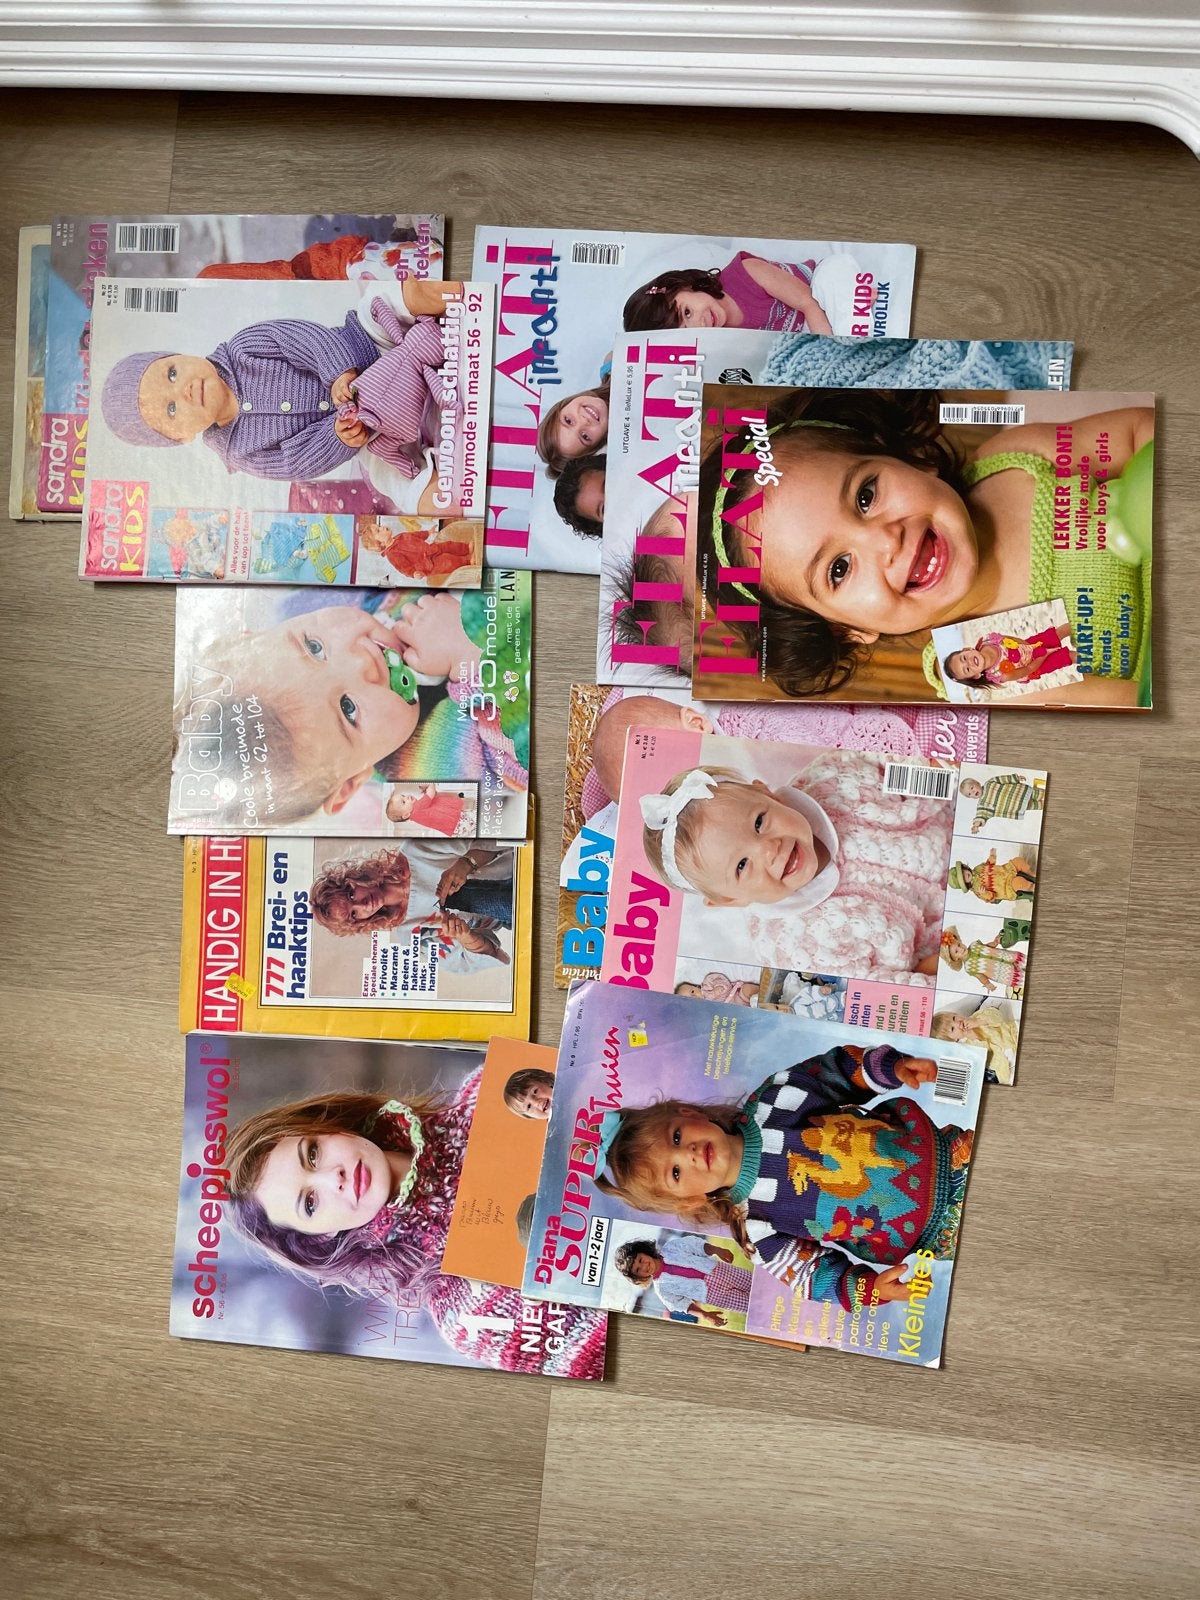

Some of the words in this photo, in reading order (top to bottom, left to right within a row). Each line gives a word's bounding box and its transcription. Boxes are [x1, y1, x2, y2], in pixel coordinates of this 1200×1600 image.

[468, 293, 483, 312] 92
[852, 272, 874, 317] KIDS
[874, 282, 890, 338] VROLIJK
[467, 328, 481, 348] 56
[528, 254, 562, 386] infanti
[438, 292, 466, 402] schattig!
[466, 352, 480, 395] maat
[464, 400, 478, 416] in
[669, 354, 706, 492] infanti
[622, 422, 630, 454] UITGAVE
[740, 416, 783, 486] Special
[1055, 425, 1073, 478] BONT!
[1096, 432, 1112, 463] girls
[41, 418, 68, 504] sandra
[432, 408, 457, 509] Gewoon
[460, 421, 478, 508] Babymode
[1077, 456, 1090, 492] mode
[1096, 468, 1108, 478] &
[1054, 486, 1071, 550] LEKKER
[1094, 484, 1110, 516] boys
[94, 484, 124, 570] sandra
[119, 486, 145, 572] KIDS
[1075, 498, 1092, 550] Vrolijke
[1096, 520, 1108, 550] voor
[505, 606, 513, 618] de
[1116, 593, 1134, 639] baby's
[514, 628, 522, 664] garens
[1076, 587, 1094, 674] START-UP!
[1100, 630, 1112, 674] Trends
[1119, 644, 1130, 674] voor
[458, 661, 468, 684] dan
[470, 659, 497, 721] 35
[246, 694, 264, 719] 104
[456, 688, 468, 722] Meer
[178, 664, 234, 810] Baby
[230, 702, 250, 782] breimode
[254, 722, 266, 739] tot
[254, 743, 268, 762] 62
[260, 768, 274, 800] maat
[484, 770, 492, 794] voor
[493, 750, 504, 796] lieverds
[240, 786, 258, 828] Coole
[264, 804, 275, 814] in
[480, 798, 492, 835] Breien
[492, 800, 504, 836] kleine
[208, 872, 242, 897] IN
[272, 852, 288, 884] en
[562, 825, 615, 966] Baby
[266, 891, 286, 950] Brei-
[286, 891, 313, 998] haaktips
[402, 948, 410, 956] &
[204, 908, 240, 1022] HANDIG
[266, 956, 286, 998] 777
[370, 965, 378, 997] Speciale
[380, 948, 388, 990] Frivolité
[390, 946, 398, 990] Macramé
[402, 958, 410, 990] Breien
[410, 960, 418, 991] haken
[419, 965, 427, 991] links-
[428, 944, 438, 991] handigen
[562, 968, 600, 980] Patricia
[362, 973, 370, 997] Extra:
[851, 991, 862, 1000] in
[890, 994, 899, 1006] en
[876, 1004, 886, 1013] in
[707, 1014, 720, 1060] nauwkeurige
[713, 1028, 726, 1080] beschrijvingen
[722, 1016, 728, 1026] en
[704, 1062, 712, 1076] Met
[554, 1108, 605, 1278] SUPER
[591, 1218, 604, 1242] jaar
[534, 1215, 562, 1284] Diana
[589, 1244, 601, 1260] 1-2
[587, 1262, 598, 1283] van
[770, 1296, 784, 1332] Pittige
[788, 1284, 804, 1334] kleurtjes
[819, 1298, 832, 1340] allerlei
[849, 1277, 867, 1346] patroontjes
[868, 1288, 880, 1317] onze
[898, 1248, 934, 1358] Kleintjes
[804, 1320, 814, 1336] en
[832, 1309, 846, 1342] leuke
[864, 1320, 875, 1347] voor
[877, 1321, 890, 1351] lieve
